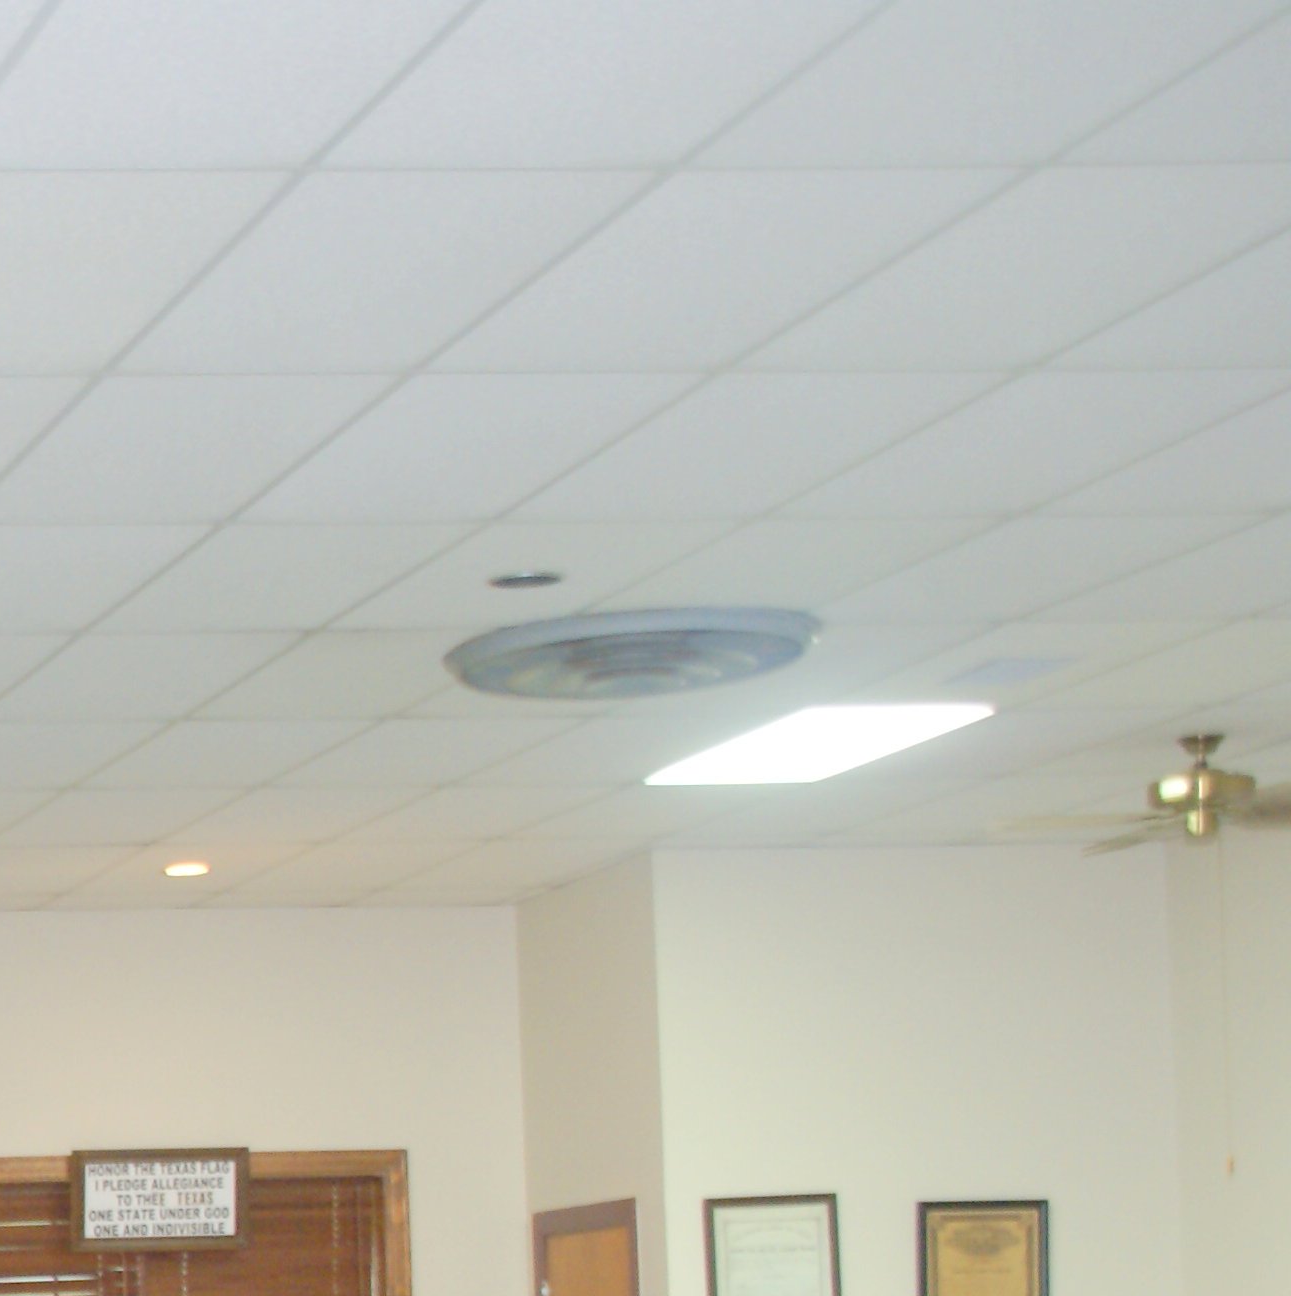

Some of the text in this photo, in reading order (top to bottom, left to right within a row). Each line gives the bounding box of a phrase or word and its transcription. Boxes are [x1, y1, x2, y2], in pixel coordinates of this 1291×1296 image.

[88, 1160, 230, 1176] HONOR THE TEXAS FLAG
[103, 1179, 147, 1191] PLEDGE
[152, 1177, 224, 1190] ALLEGIANCE
[117, 1191, 214, 1206] TO THEE TEXAS
[89, 1207, 229, 1222] ONE STATE UNDER GOD
[94, 1222, 225, 1237] ONE AND INDIVISIBLE
